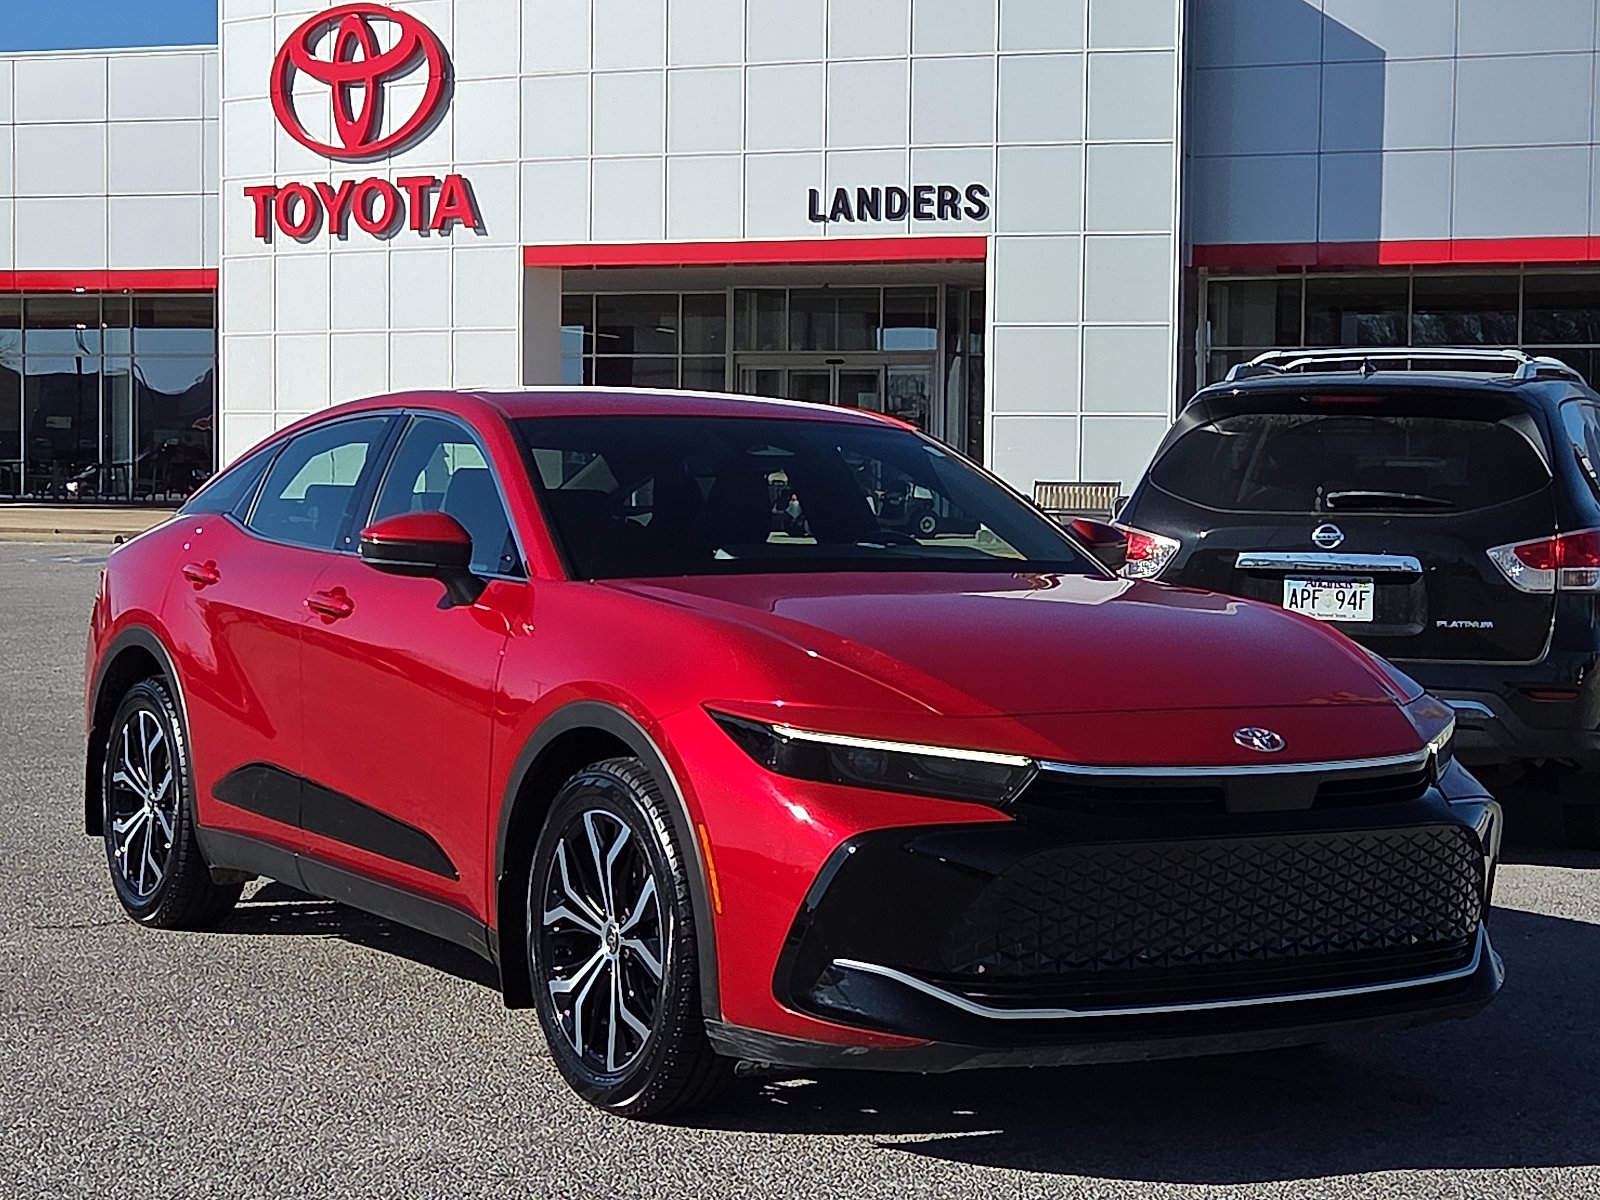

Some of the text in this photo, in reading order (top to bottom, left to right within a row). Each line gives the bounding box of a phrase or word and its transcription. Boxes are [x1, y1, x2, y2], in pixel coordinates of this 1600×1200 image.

[244, 174, 483, 241] TOYOTA
[808, 184, 990, 222] LANDERS
[1288, 588, 1371, 611] APF 94F
[1436, 620, 1494, 629] PLATINUM
